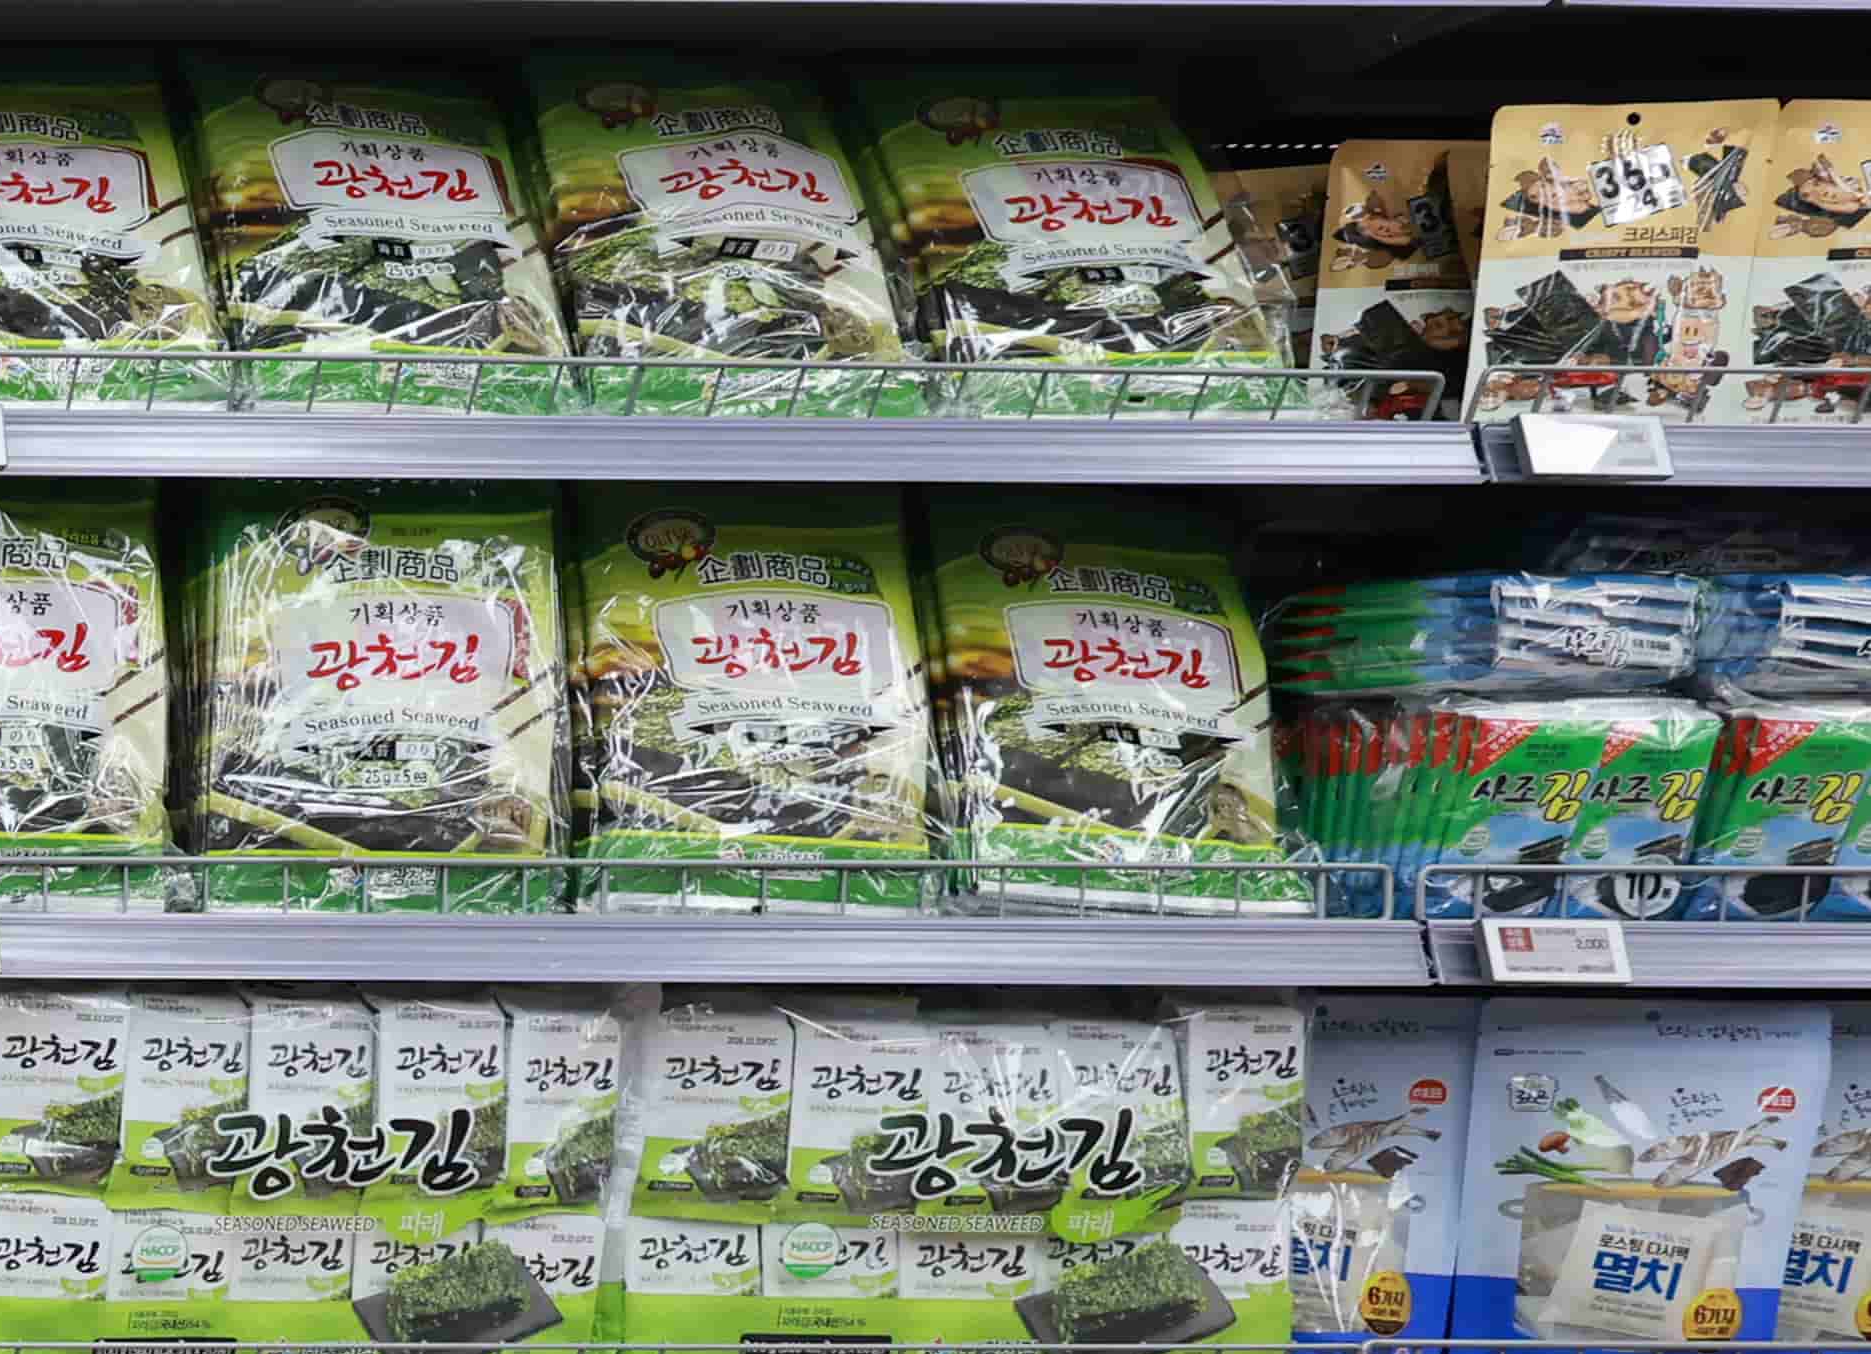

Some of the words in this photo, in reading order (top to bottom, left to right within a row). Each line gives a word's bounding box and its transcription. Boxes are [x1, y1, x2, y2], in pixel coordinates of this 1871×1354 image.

[312, 159, 477, 202] 광천김
[659, 158, 829, 204] 광천김
[324, 213, 404, 231] Seasoned
[409, 215, 494, 237] Seaweed
[1006, 194, 1177, 231] 광천김
[349, 601, 446, 624] 기획상품
[725, 598, 822, 624] 기획상품
[1076, 608, 1166, 637] 기획상품
[307, 632, 480, 691] 광천김
[7, 694, 89, 721] Seaweed
[304, 710, 395, 734] Seasoned
[400, 707, 480, 732] Seaweed
[697, 695, 782, 717] Seasoned
[788, 698, 874, 719] Seaweed
[1045, 700, 1132, 722] Seasoned
[1137, 705, 1219, 731] Seaweed
[207, 1105, 481, 1199] 광천김
[866, 1109, 1143, 1198] 광천김
[399, 1213, 444, 1235] 파래
[871, 1215, 960, 1232] SEASONED
[965, 1215, 1042, 1232] SEAWEED
[1069, 1209, 1114, 1236] 파래
[1599, 1232, 1643, 1251] 로스팅
[1647, 1240, 1690, 1261] 다시팩
[1591, 1251, 1683, 1301] 멸치
